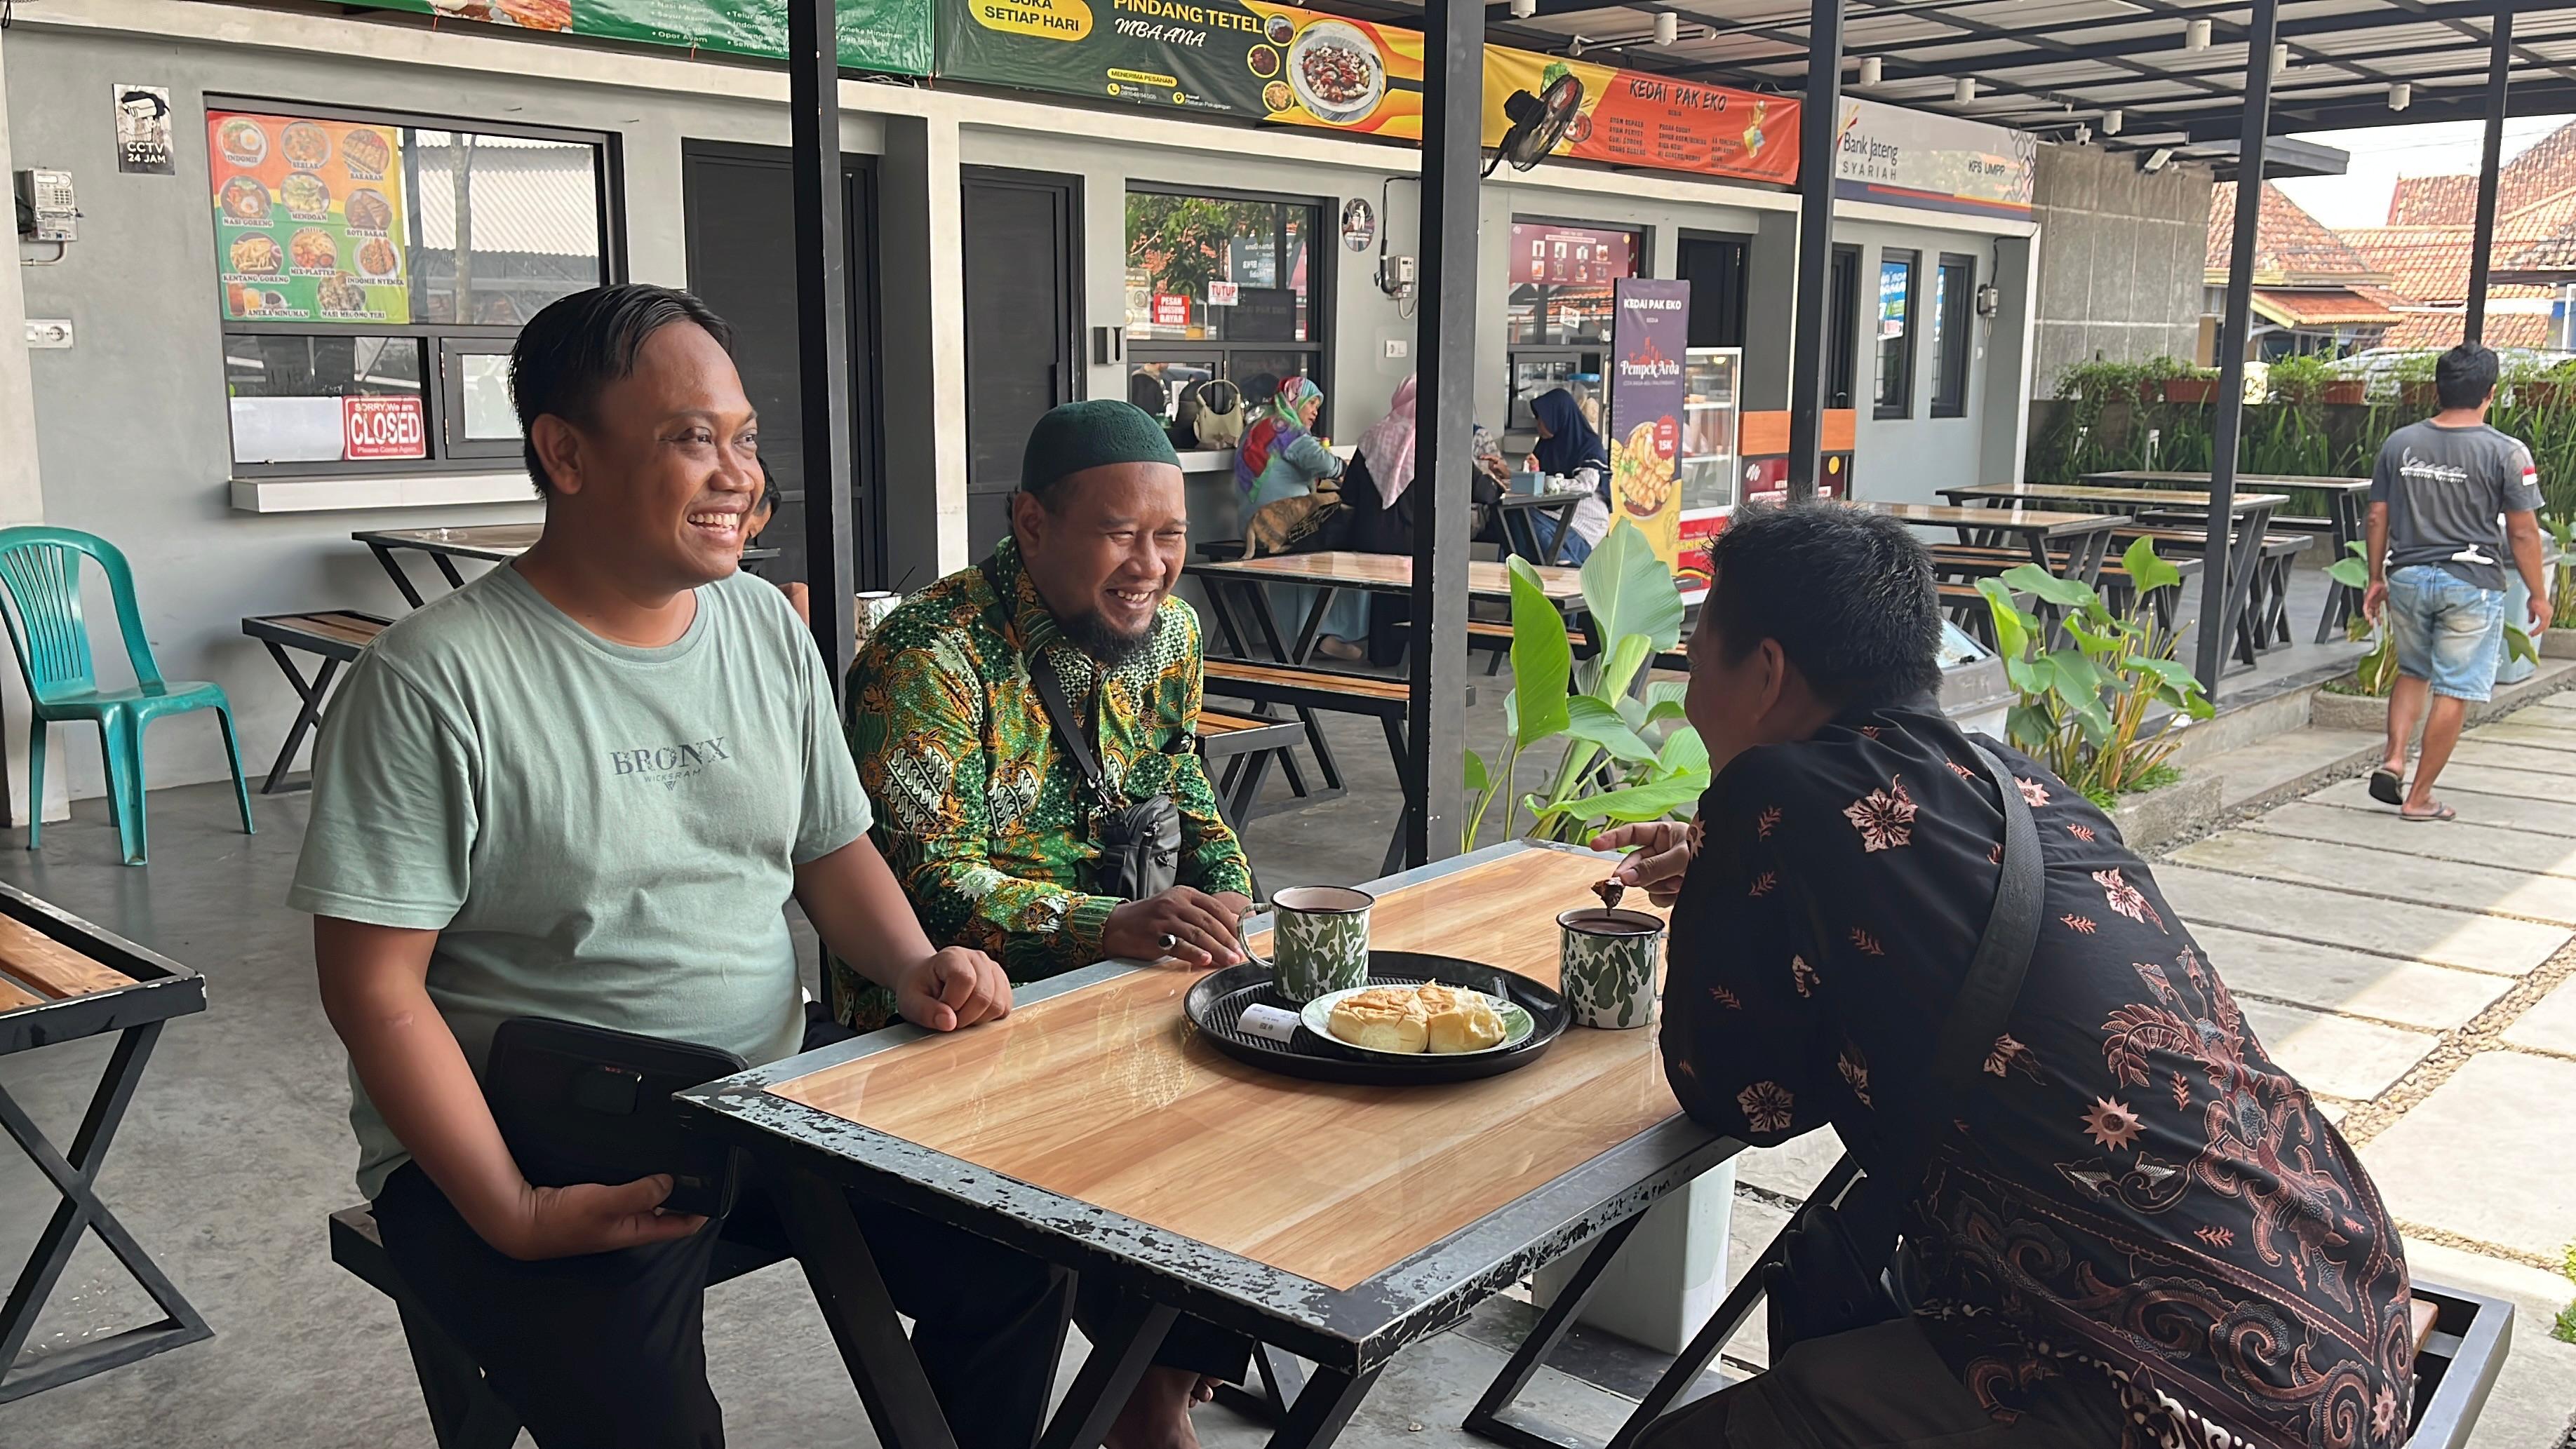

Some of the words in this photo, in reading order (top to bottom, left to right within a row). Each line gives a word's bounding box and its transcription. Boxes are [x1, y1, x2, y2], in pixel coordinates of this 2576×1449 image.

[985, 6, 1039, 24] SETIAP
[1043, 15, 1079, 32] HARI
[1113, 0, 1203, 23] PINDANG
[1206, 9, 1263, 34] TETEL
[658, 31, 680, 39] Opor
[683, 34, 708, 43] Ayam
[840, 26, 864, 34] Aneka
[867, 29, 903, 39] Minuman
[1115, 18, 1163, 40] MBA
[1163, 27, 1207, 47] ANA
[1111, 70, 1143, 81] MENERIMA
[1144, 74, 1174, 84] PESANAN
[1630, 79, 1668, 103] KEDAI
[1675, 87, 1699, 108] PAK
[1703, 92, 1728, 112] EKO
[127, 142, 164, 154] CCTV
[1844, 132, 1867, 155] Bank
[1868, 137, 1898, 166] Jateng
[128, 154, 141, 162] 24
[144, 154, 166, 163] JAM
[227, 154, 258, 163] INDOMIE
[1843, 161, 1897, 181] SYARIAH
[1985, 162, 2005, 175] UMPP
[1212, 285, 1235, 297] TUTUP
[1160, 296, 1183, 306] PESAN
[1623, 299, 1648, 309] KEDAI
[1649, 299, 1665, 309] PAK
[1665, 300, 1682, 310] EKO
[1159, 314, 1184, 323] BAYAR
[1621, 360, 1656, 379] Pempek
[1655, 359, 1679, 378] Arda
[351, 412, 421, 445] CLOSED
[1658, 439, 1673, 451] 15K
[610, 736, 729, 776] BRONX
